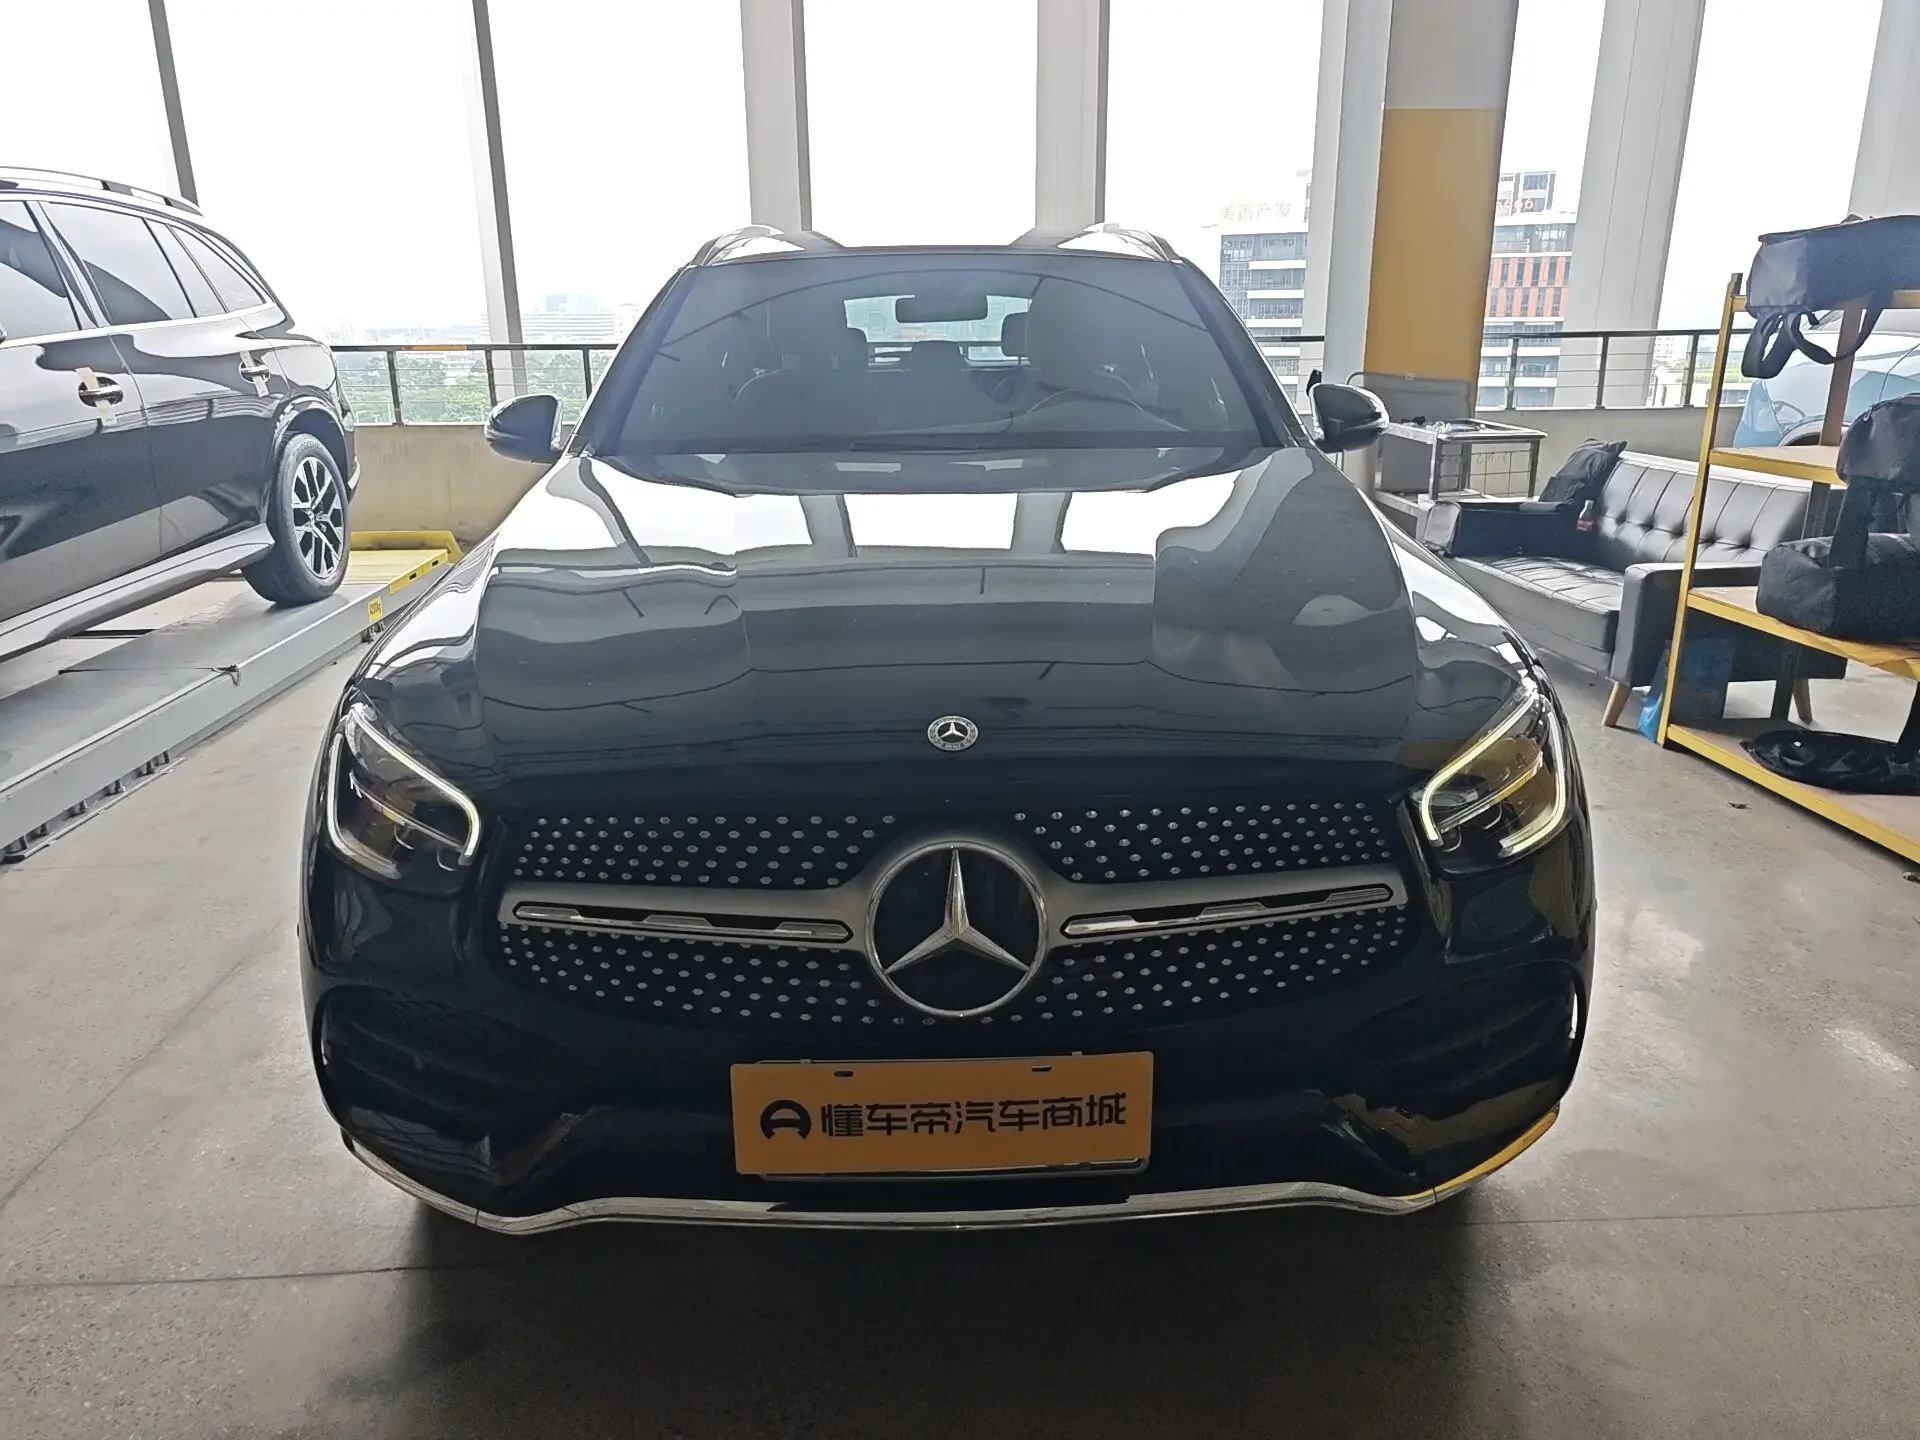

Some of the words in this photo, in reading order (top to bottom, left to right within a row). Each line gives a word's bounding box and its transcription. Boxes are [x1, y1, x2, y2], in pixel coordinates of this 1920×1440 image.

[820, 1091, 1127, 1138] 懂车帝汽车商城
